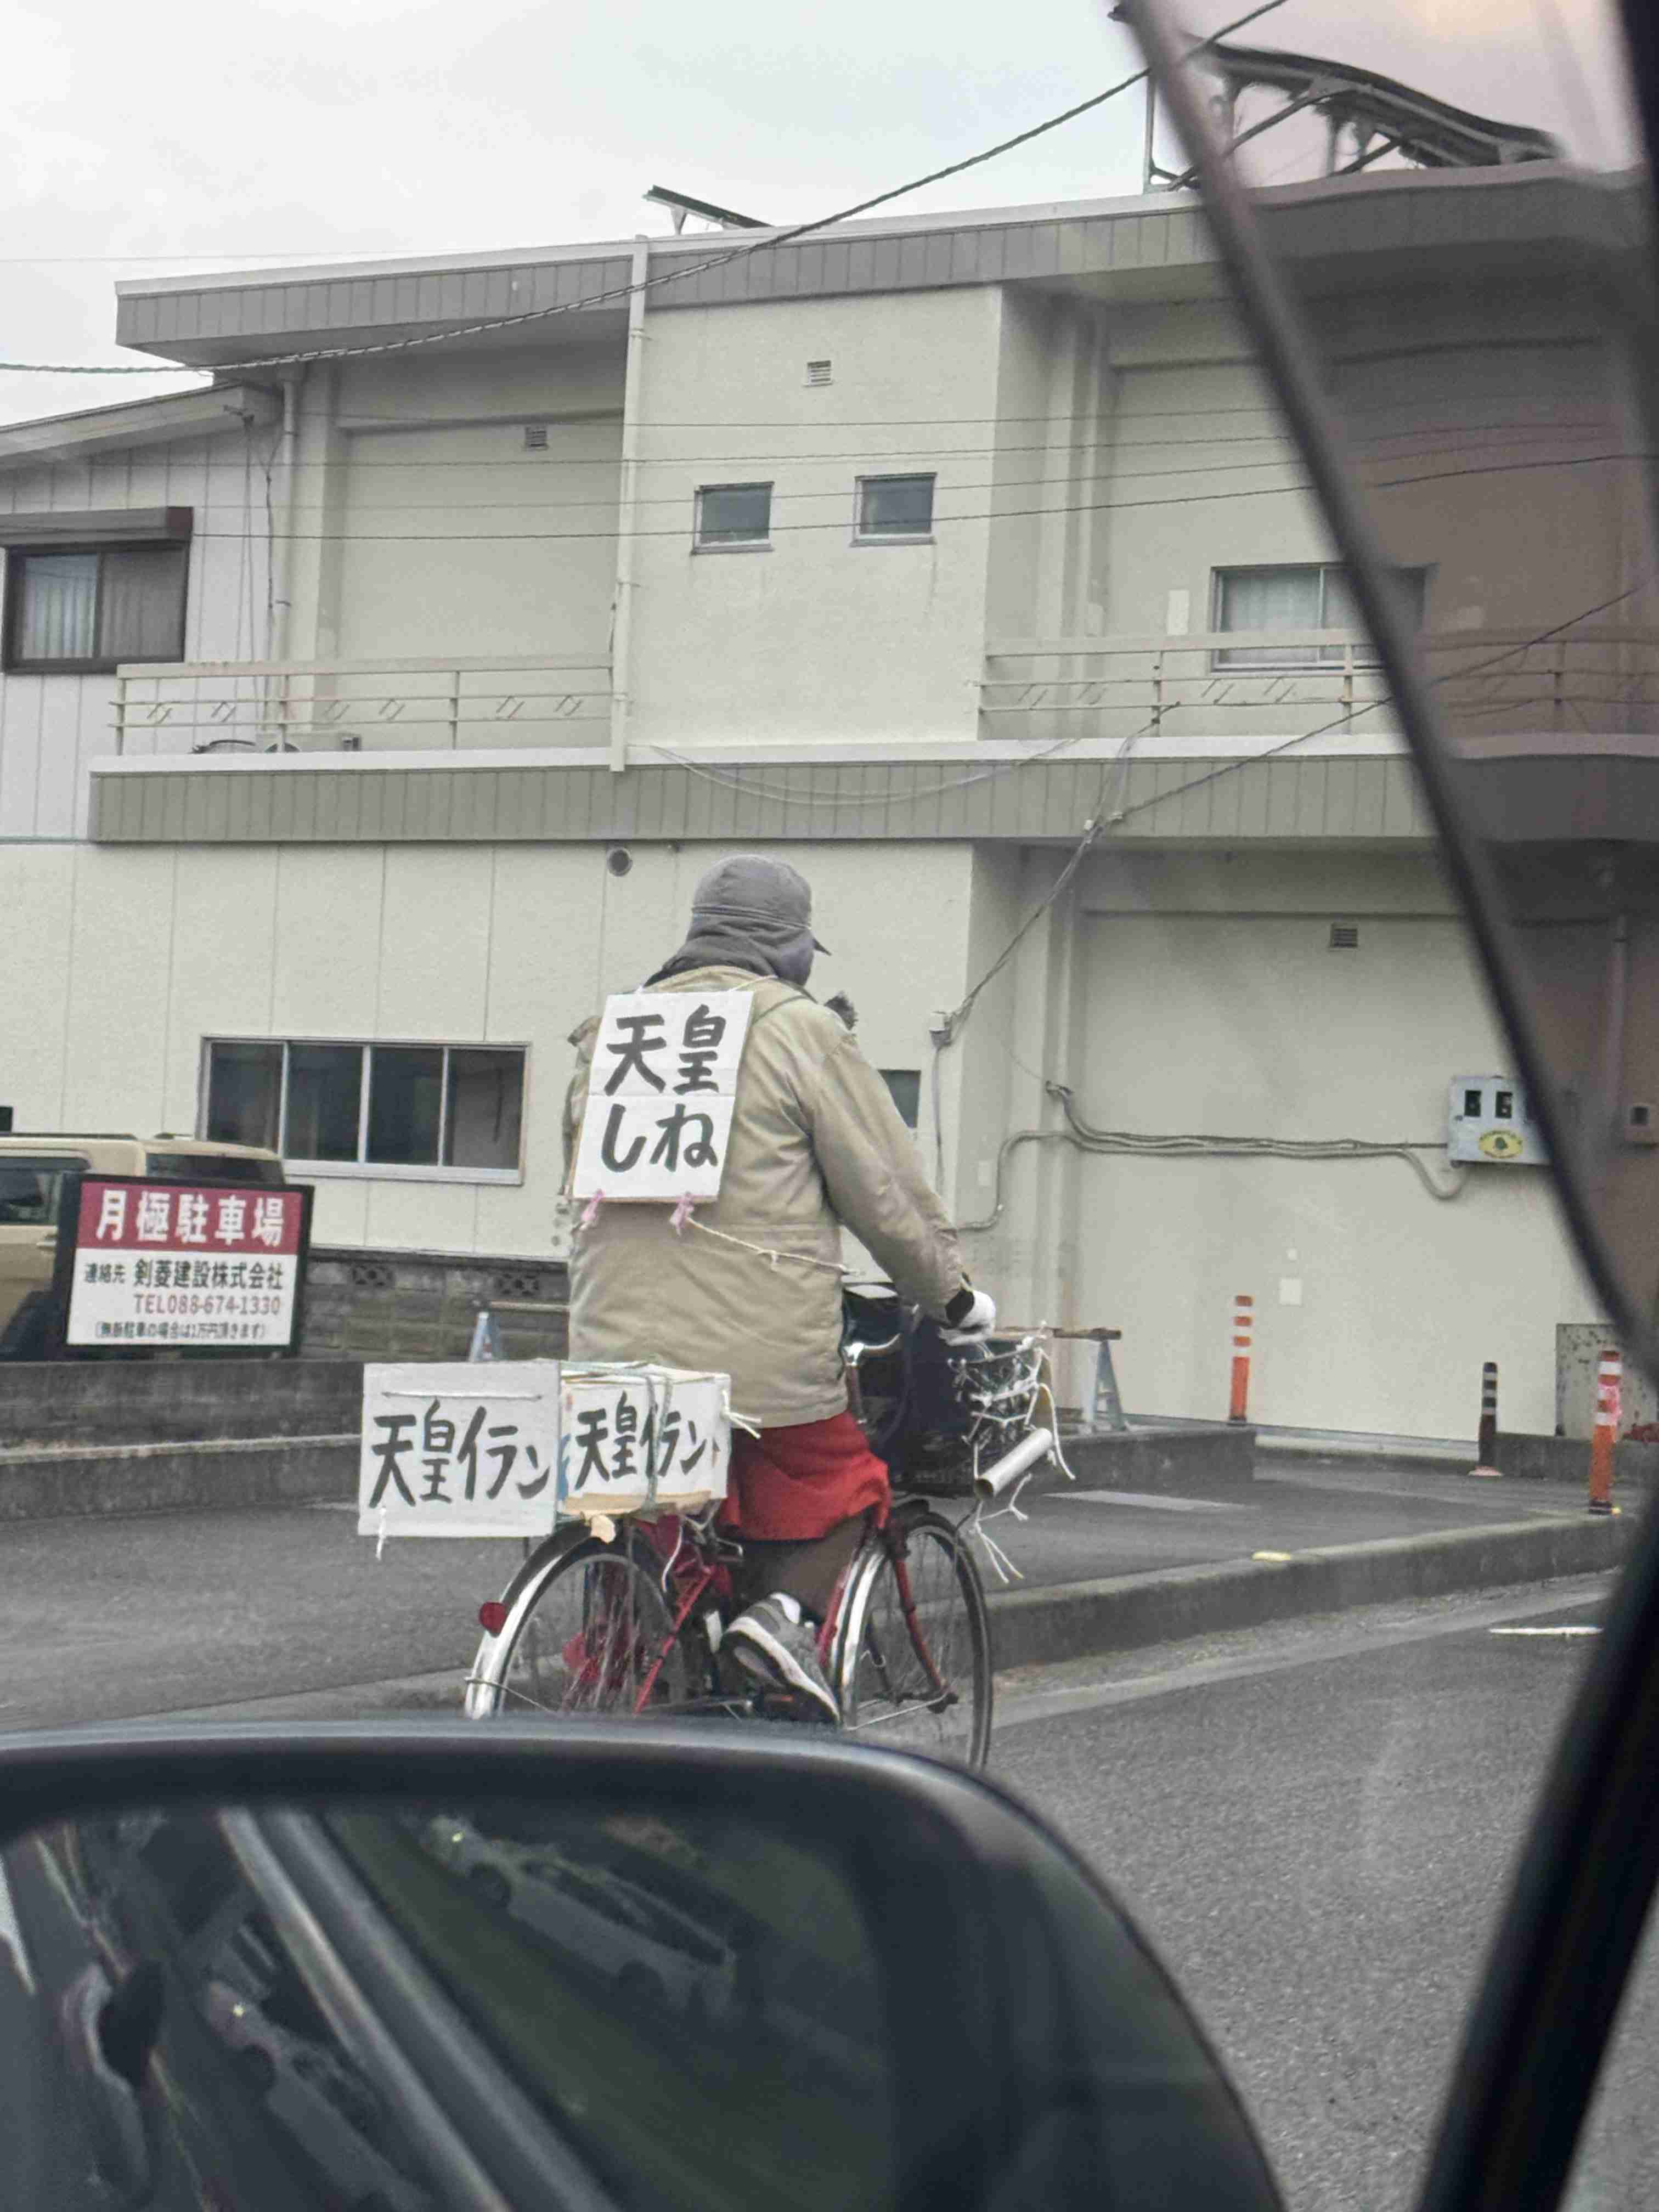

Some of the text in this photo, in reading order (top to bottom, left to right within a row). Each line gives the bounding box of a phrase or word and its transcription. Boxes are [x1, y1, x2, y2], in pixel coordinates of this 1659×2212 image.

[604, 1004, 726, 1096] 天皇
[601, 1103, 718, 1172] しね
[97, 1189, 284, 1246] 月極駐車場
[84, 1262, 126, 1283] 連絡先
[369, 1399, 549, 1508] 天皇イラン
